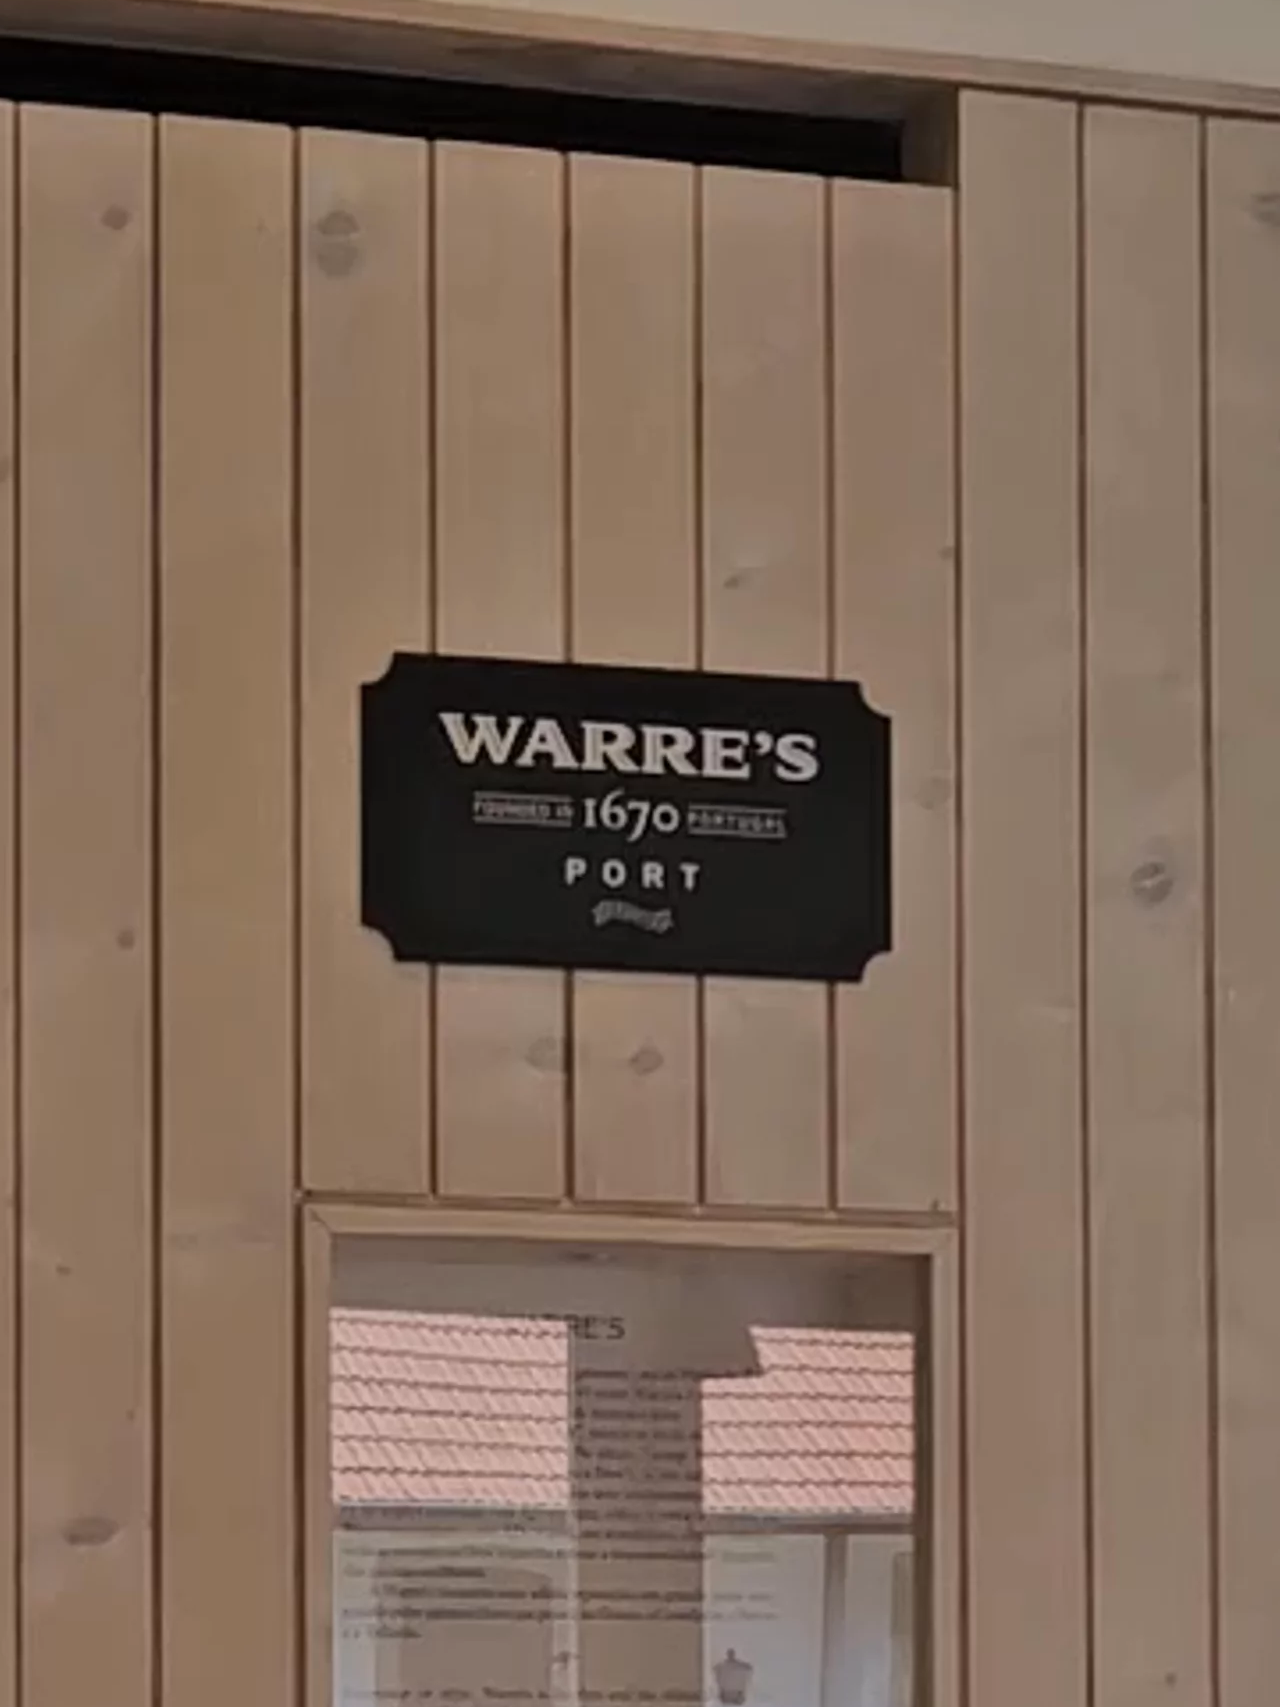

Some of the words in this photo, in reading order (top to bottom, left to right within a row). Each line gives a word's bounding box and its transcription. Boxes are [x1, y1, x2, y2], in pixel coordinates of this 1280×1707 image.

[438, 711, 820, 783] WARRE'S
[582, 786, 680, 843] 1670
[565, 856, 702, 892] PORT
